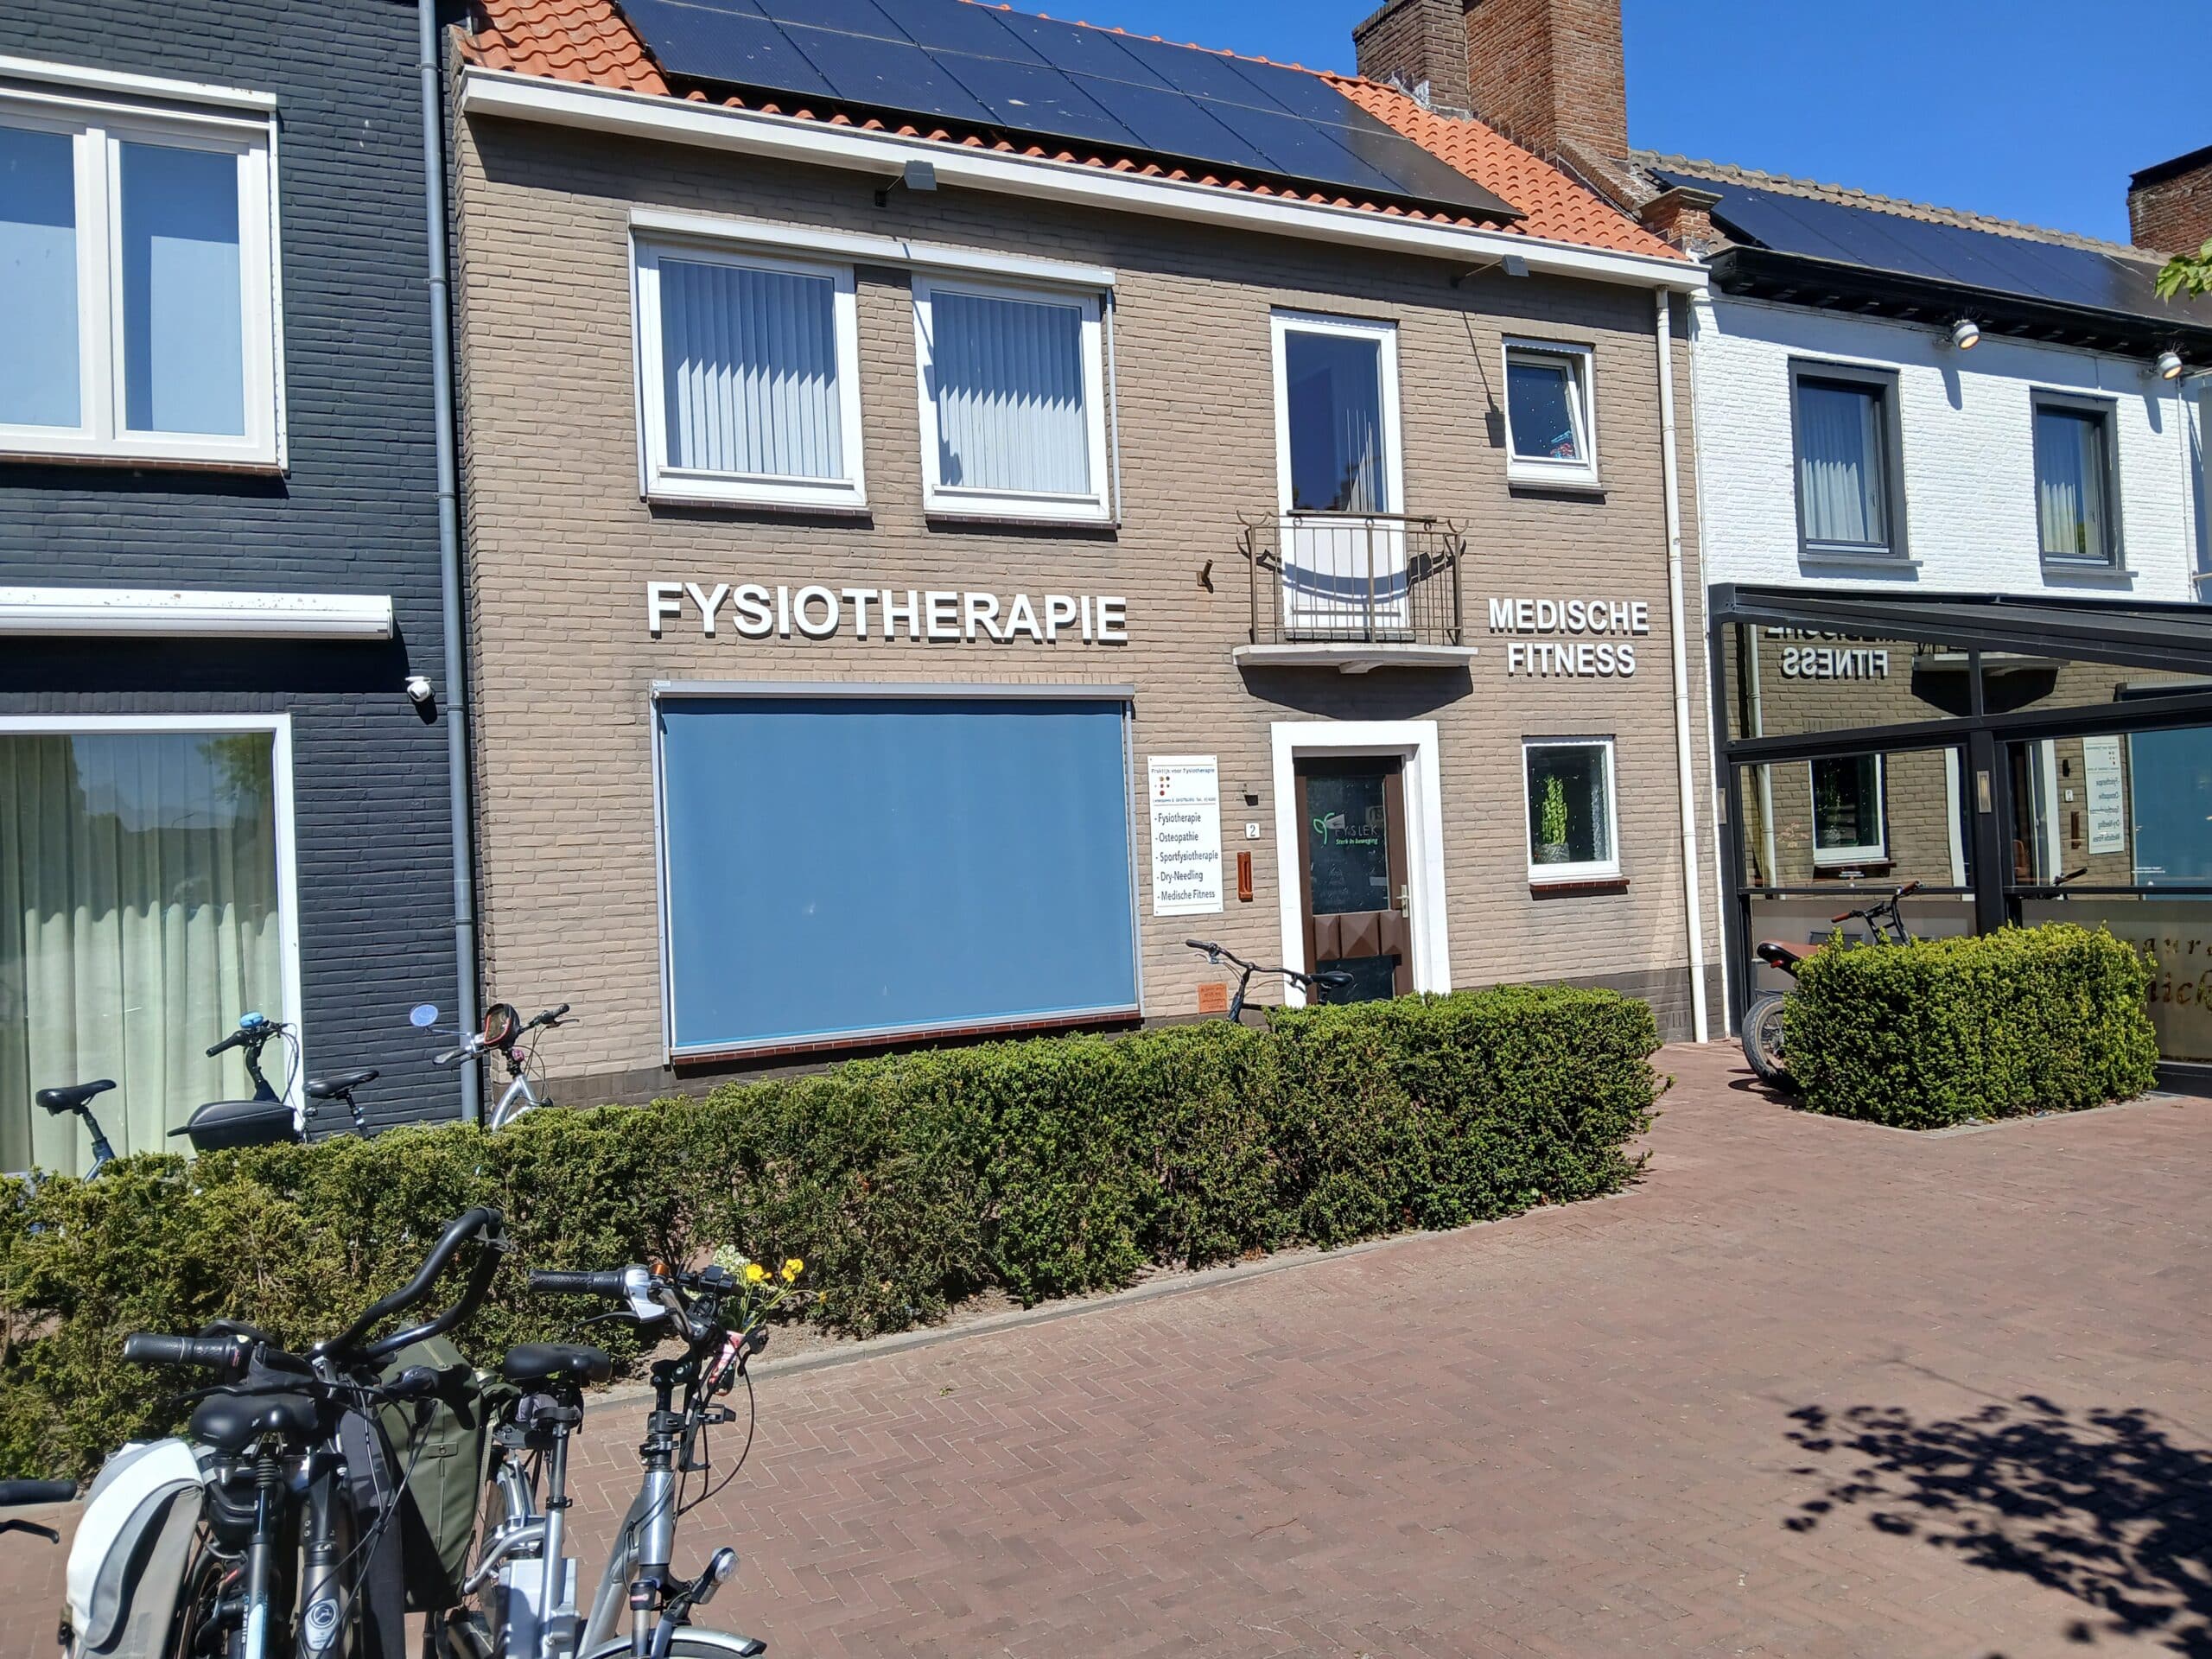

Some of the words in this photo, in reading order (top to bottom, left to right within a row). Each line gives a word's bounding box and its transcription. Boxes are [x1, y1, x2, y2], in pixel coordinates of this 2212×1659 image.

[646, 581, 1128, 640] FYSIOTHERAPIE
[1488, 598, 1649, 632] MEDISCHE
[1507, 642, 1636, 675] FITNESS
[1249, 824, 1255, 836] 2
[1161, 889, 1192, 900] Medische
[1192, 889, 1216, 899] Fitness
